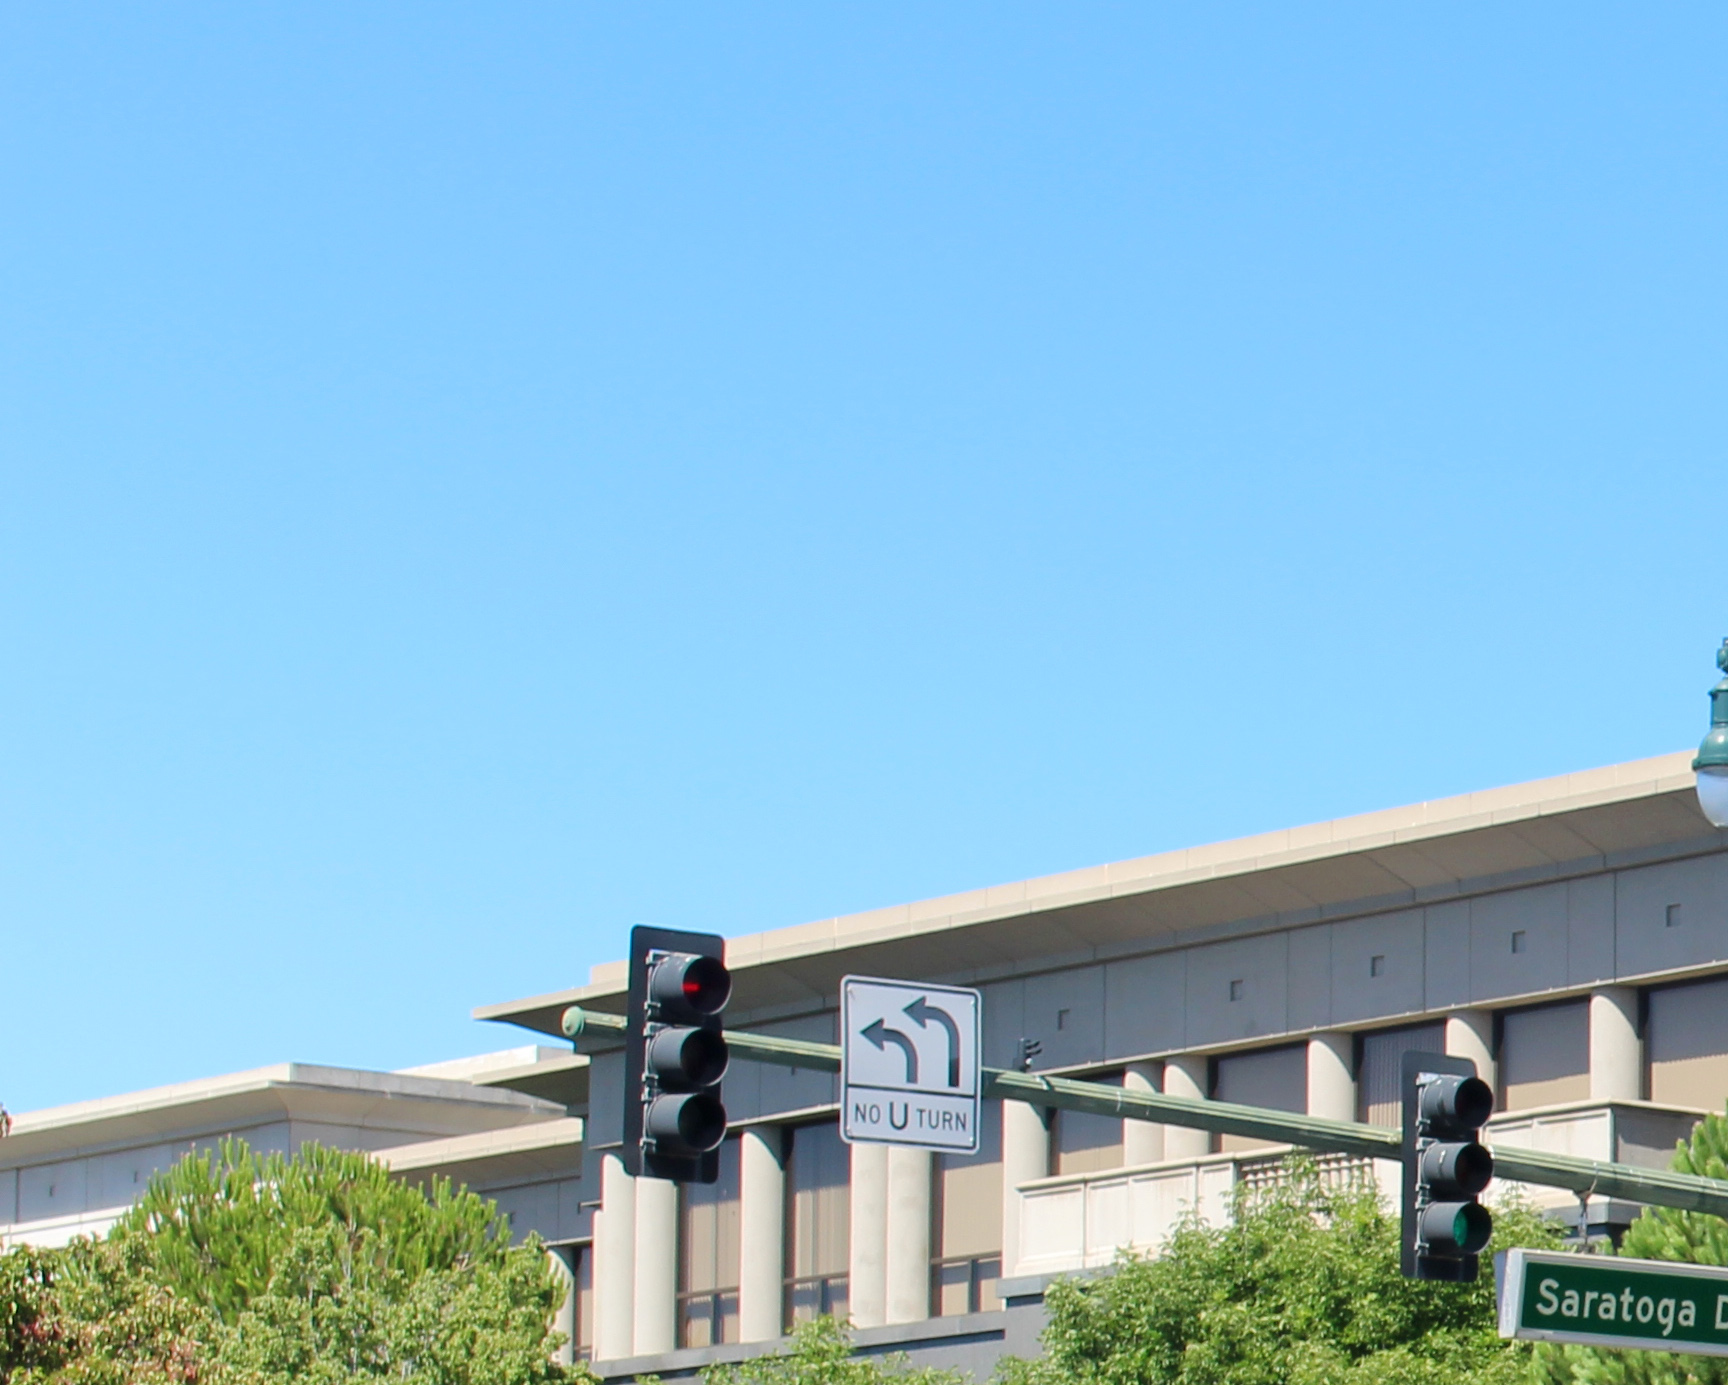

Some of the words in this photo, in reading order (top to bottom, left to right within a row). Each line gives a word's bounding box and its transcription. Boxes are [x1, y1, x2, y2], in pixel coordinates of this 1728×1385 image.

[855, 1103, 880, 1124] NO
[890, 1102, 908, 1130] U
[916, 1109, 967, 1132] TURN
[1536, 1278, 1697, 1336] Saratoga
